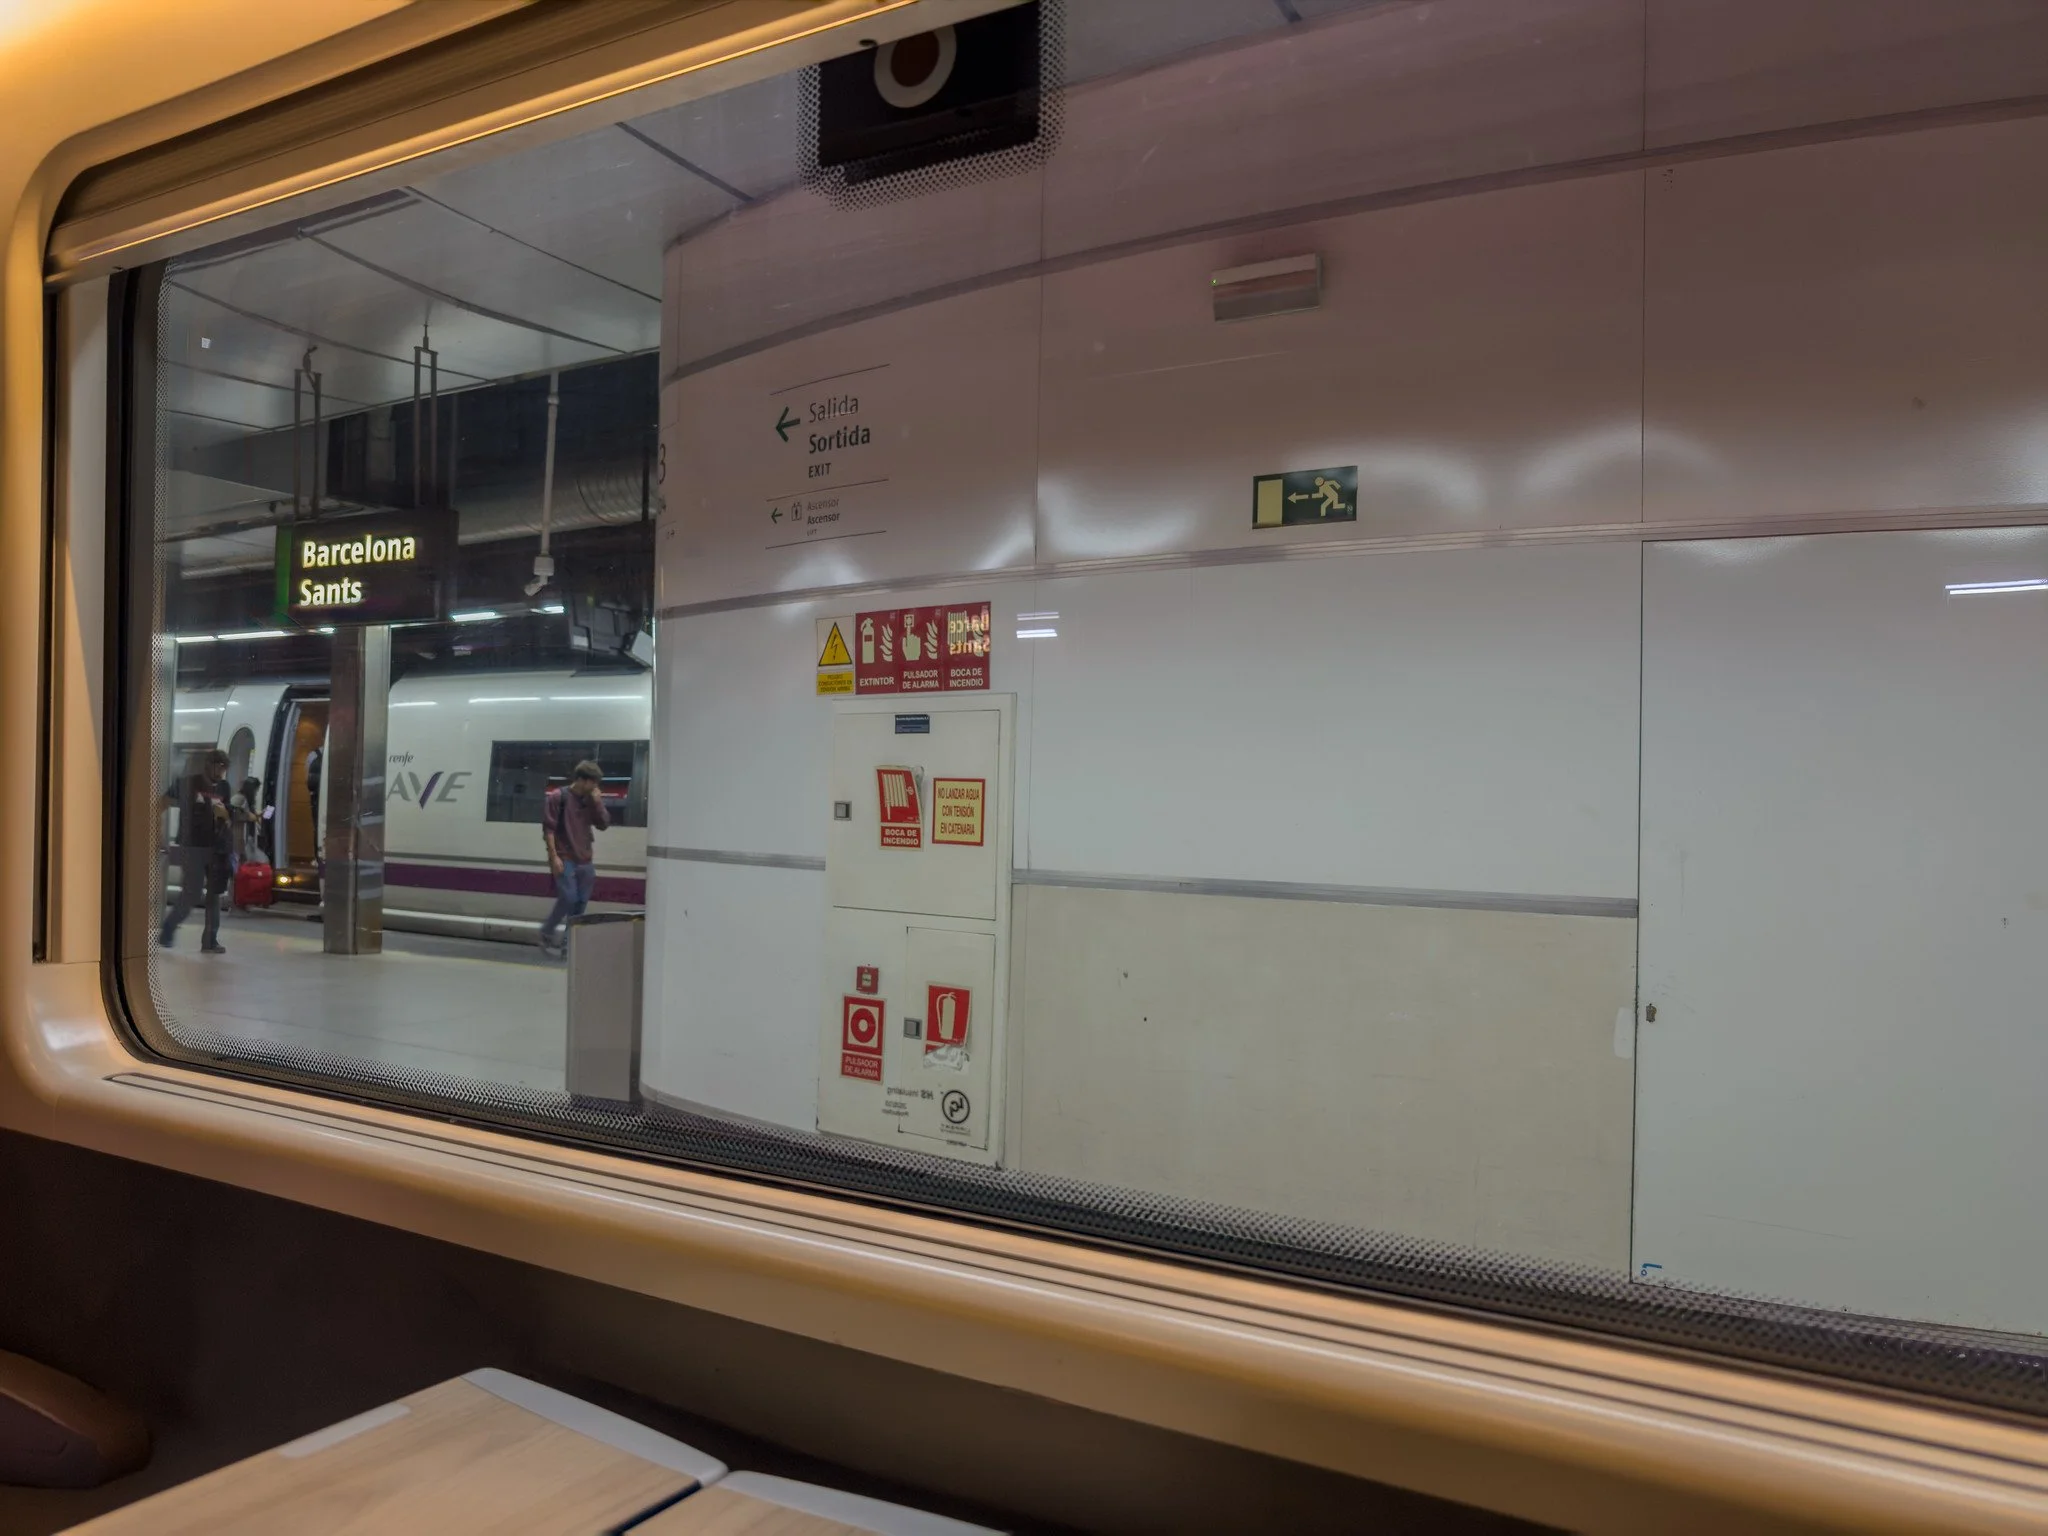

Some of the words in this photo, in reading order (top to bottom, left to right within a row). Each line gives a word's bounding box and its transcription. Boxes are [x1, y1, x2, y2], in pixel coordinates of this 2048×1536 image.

[809, 395, 859, 423] Salida
[809, 425, 870, 454] Sortida
[658, 443, 667, 484] 3
[808, 463, 831, 478] EXIT
[807, 498, 839, 511] Ascensor
[807, 512, 840, 525] Ascensor
[303, 535, 415, 568] Barcelona
[300, 577, 362, 606] Sants
[903, 670, 939, 679] PULSADOR
[950, 668, 971, 677] BOCA
[972, 668, 983, 676] DE
[860, 677, 894, 687] EXTINTOR
[902, 681, 911, 689] DE
[912, 680, 940, 689] ALARMA
[949, 678, 984, 688] INCENDIO
[388, 752, 414, 766] renfe
[387, 771, 472, 810] AVE
[938, 788, 945, 798] NO
[945, 788, 965, 799] LANZAR
[965, 788, 980, 800] AGUA
[942, 804, 953, 817] CON
[953, 803, 974, 818] TENSIÓN
[885, 828, 906, 836] BOCA
[906, 829, 917, 837] DE
[940, 822, 948, 834] EN
[948, 823, 975, 836] CATENARIA
[883, 837, 919, 845] INCENDIO
